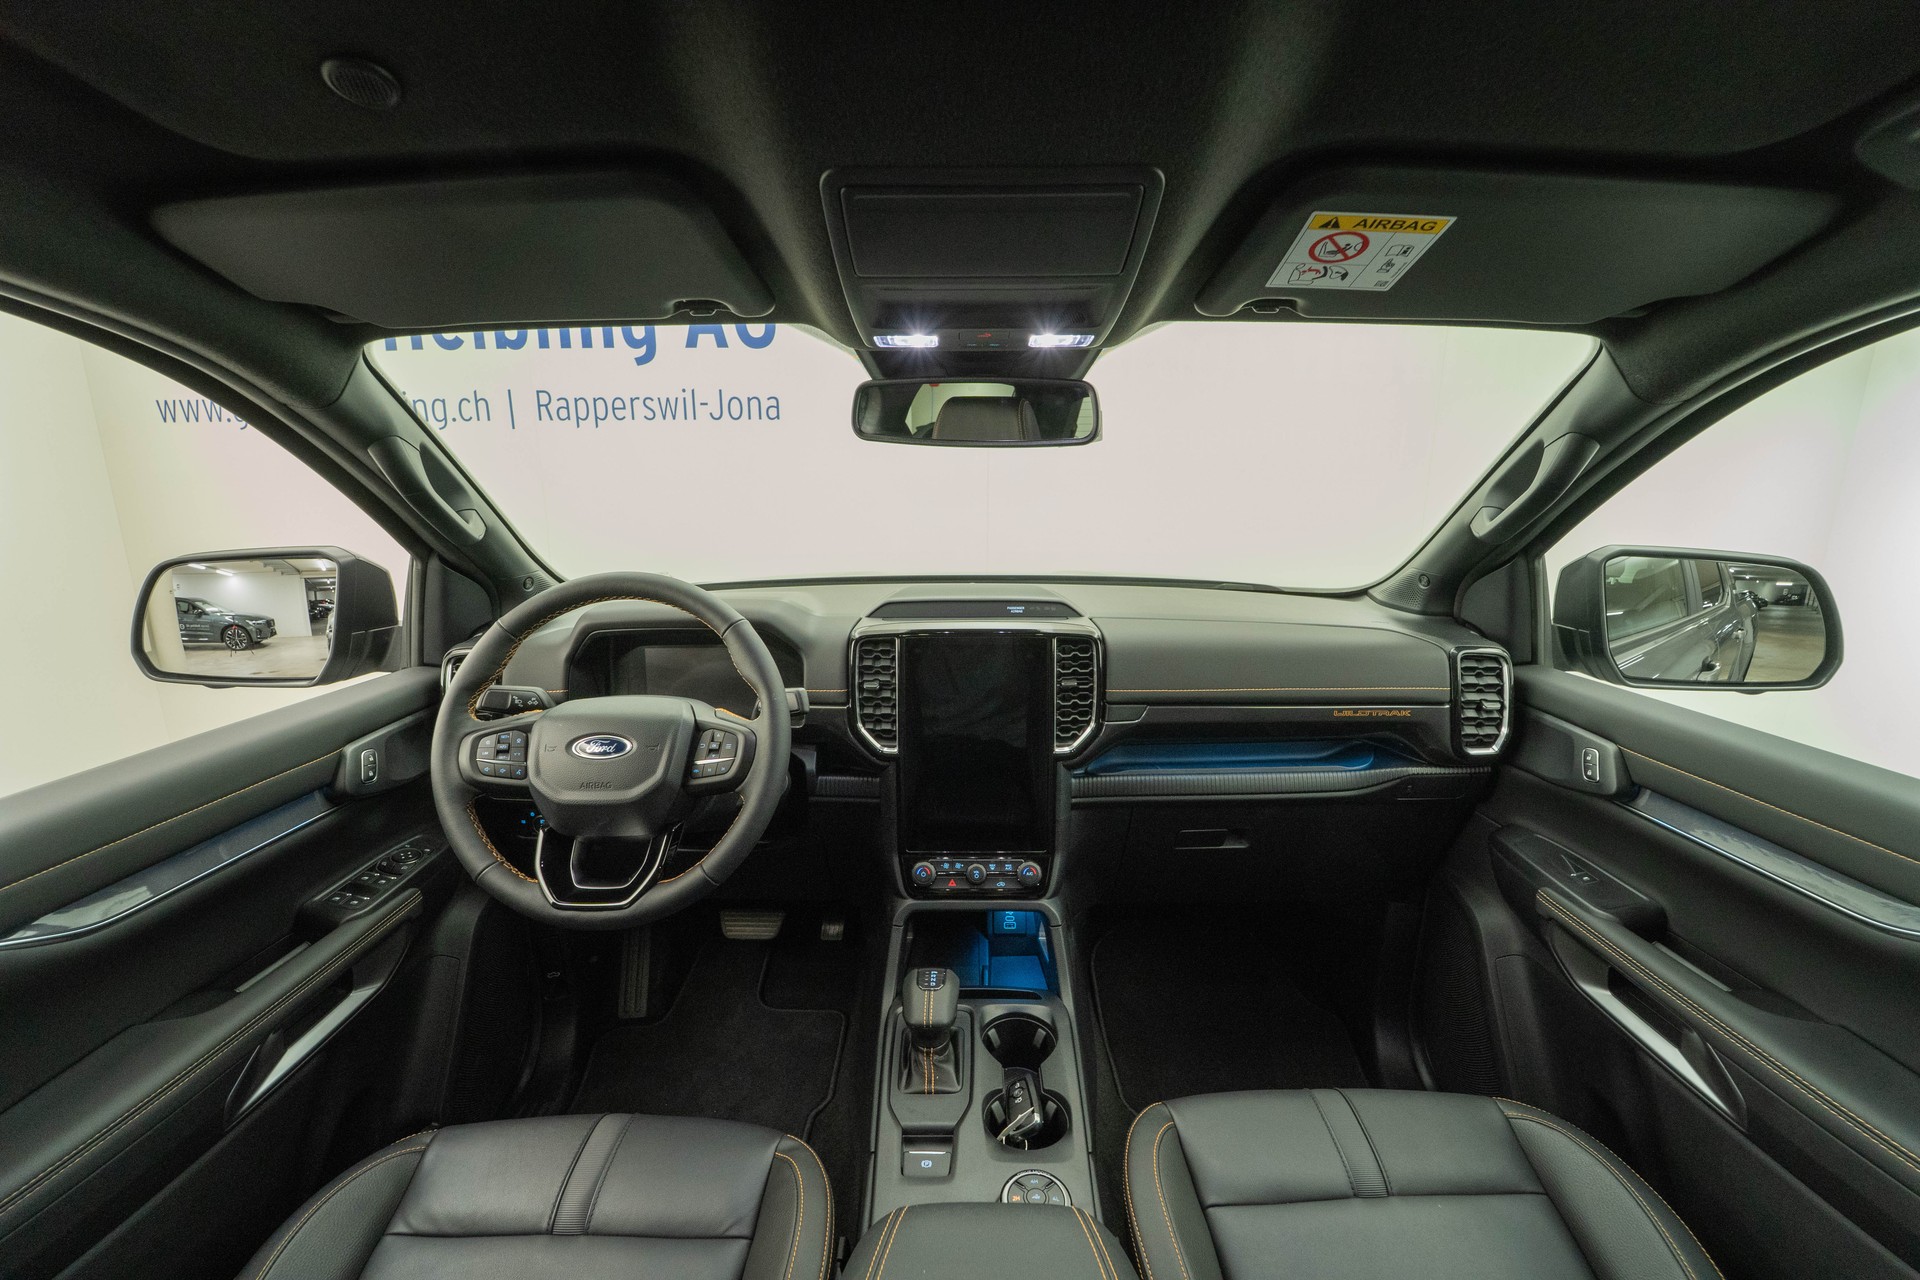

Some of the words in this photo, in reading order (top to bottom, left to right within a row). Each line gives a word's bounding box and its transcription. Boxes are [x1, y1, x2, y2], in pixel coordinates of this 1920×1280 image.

[1352, 218, 1438, 231] AIRBAG
[535, 388, 781, 428] Rapperswil-Jona
[585, 740, 618, 754] Ford
[579, 781, 613, 790] AIRBAG
